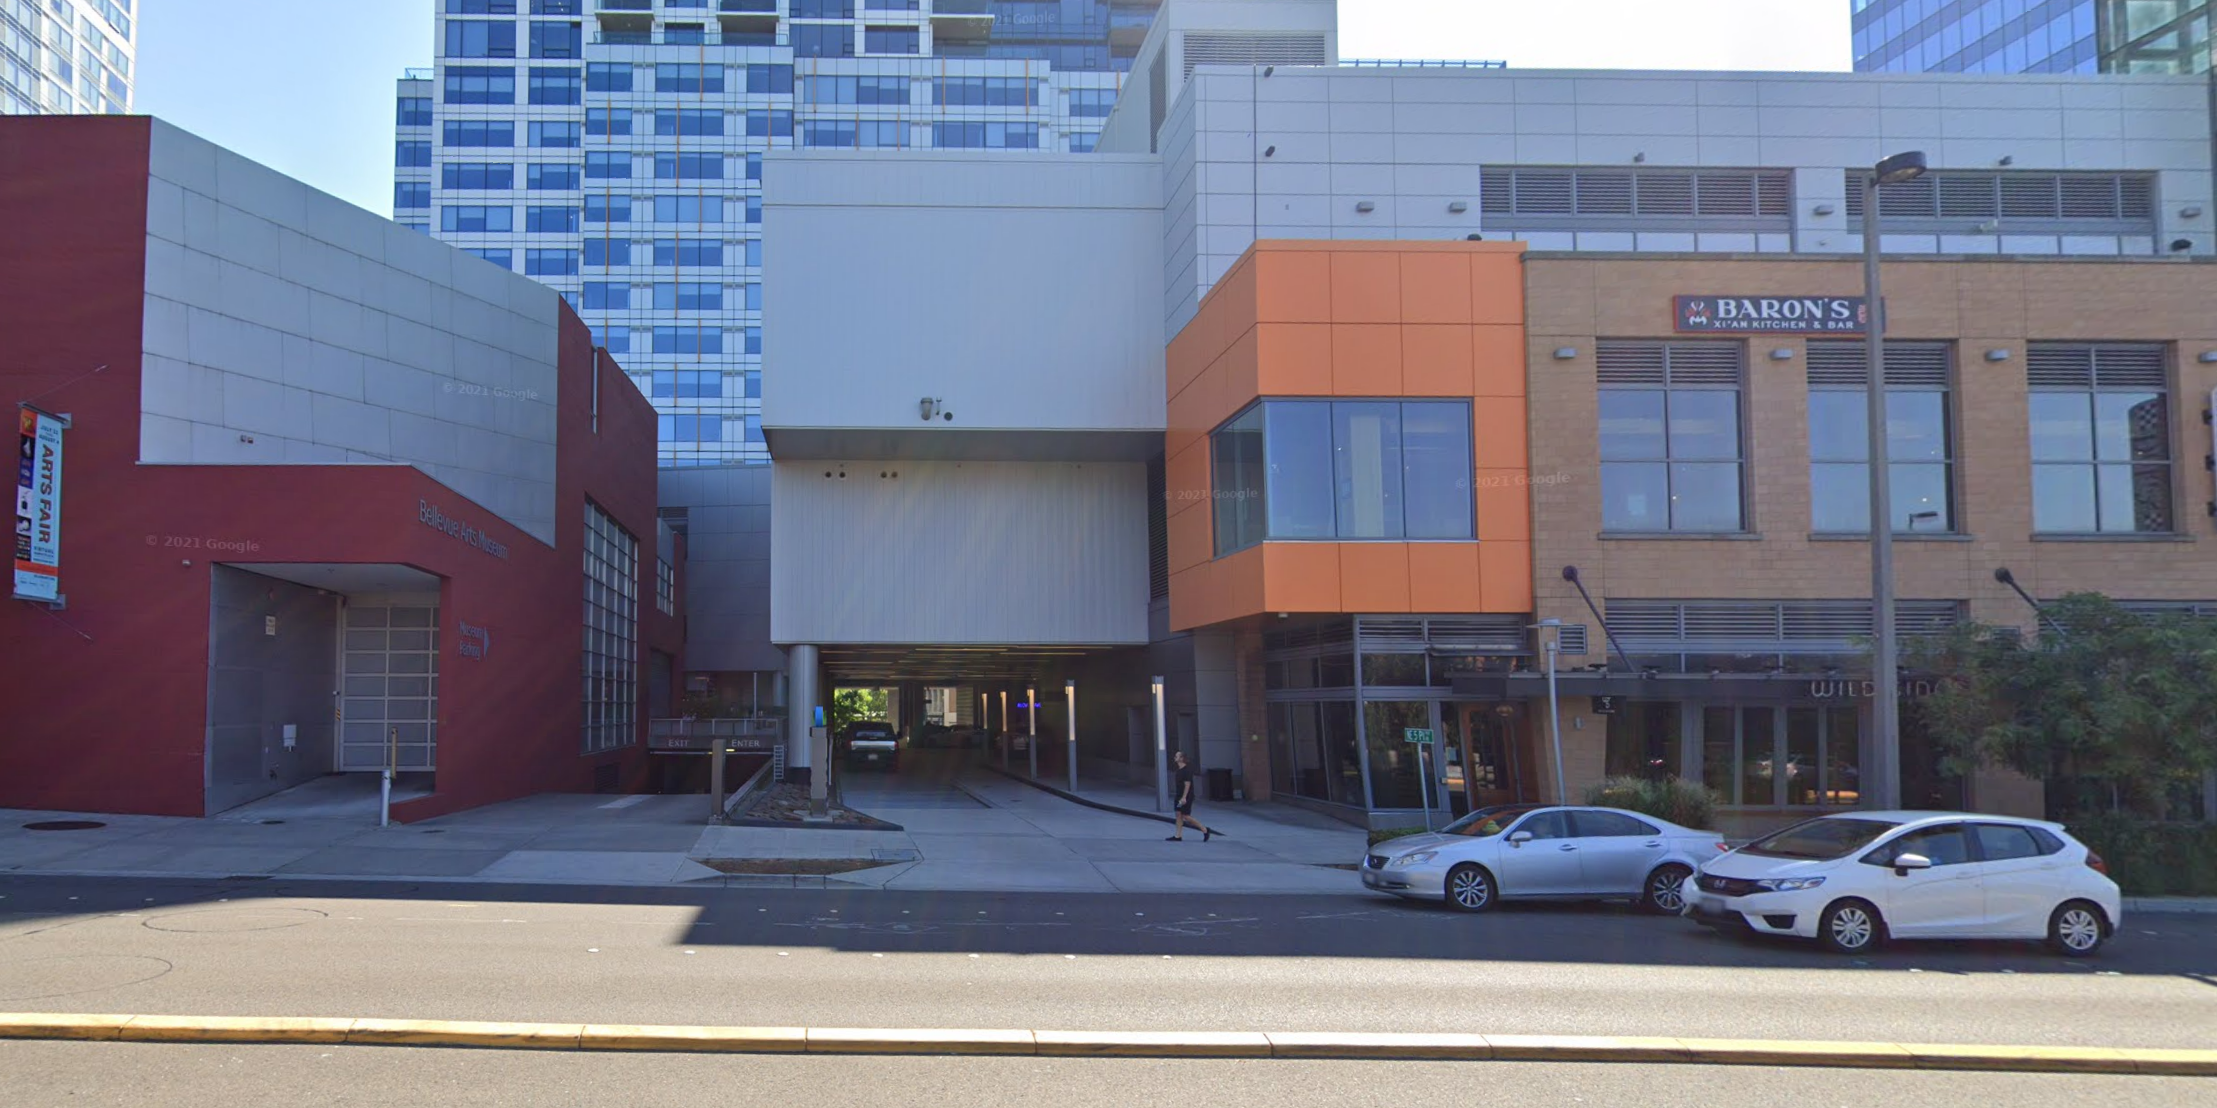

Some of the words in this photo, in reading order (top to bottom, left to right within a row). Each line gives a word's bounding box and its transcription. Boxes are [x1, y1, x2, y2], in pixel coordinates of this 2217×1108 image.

[1717, 298, 1850, 319] BARON'S
[1714, 320, 1748, 329] XI'AN
[1752, 320, 1806, 329] KITCHEN
[1812, 320, 1822, 329] &
[1828, 320, 1854, 329] BAR
[40, 444, 54, 496] ARTS
[39, 499, 52, 543] FAIR
[419, 499, 459, 538] Bellevue
[461, 520, 477, 547] Arts
[478, 529, 508, 559] Museum
[1811, 680, 1876, 698] WILD
[668, 740, 689, 748] EXIT
[732, 740, 760, 748] ENTER
